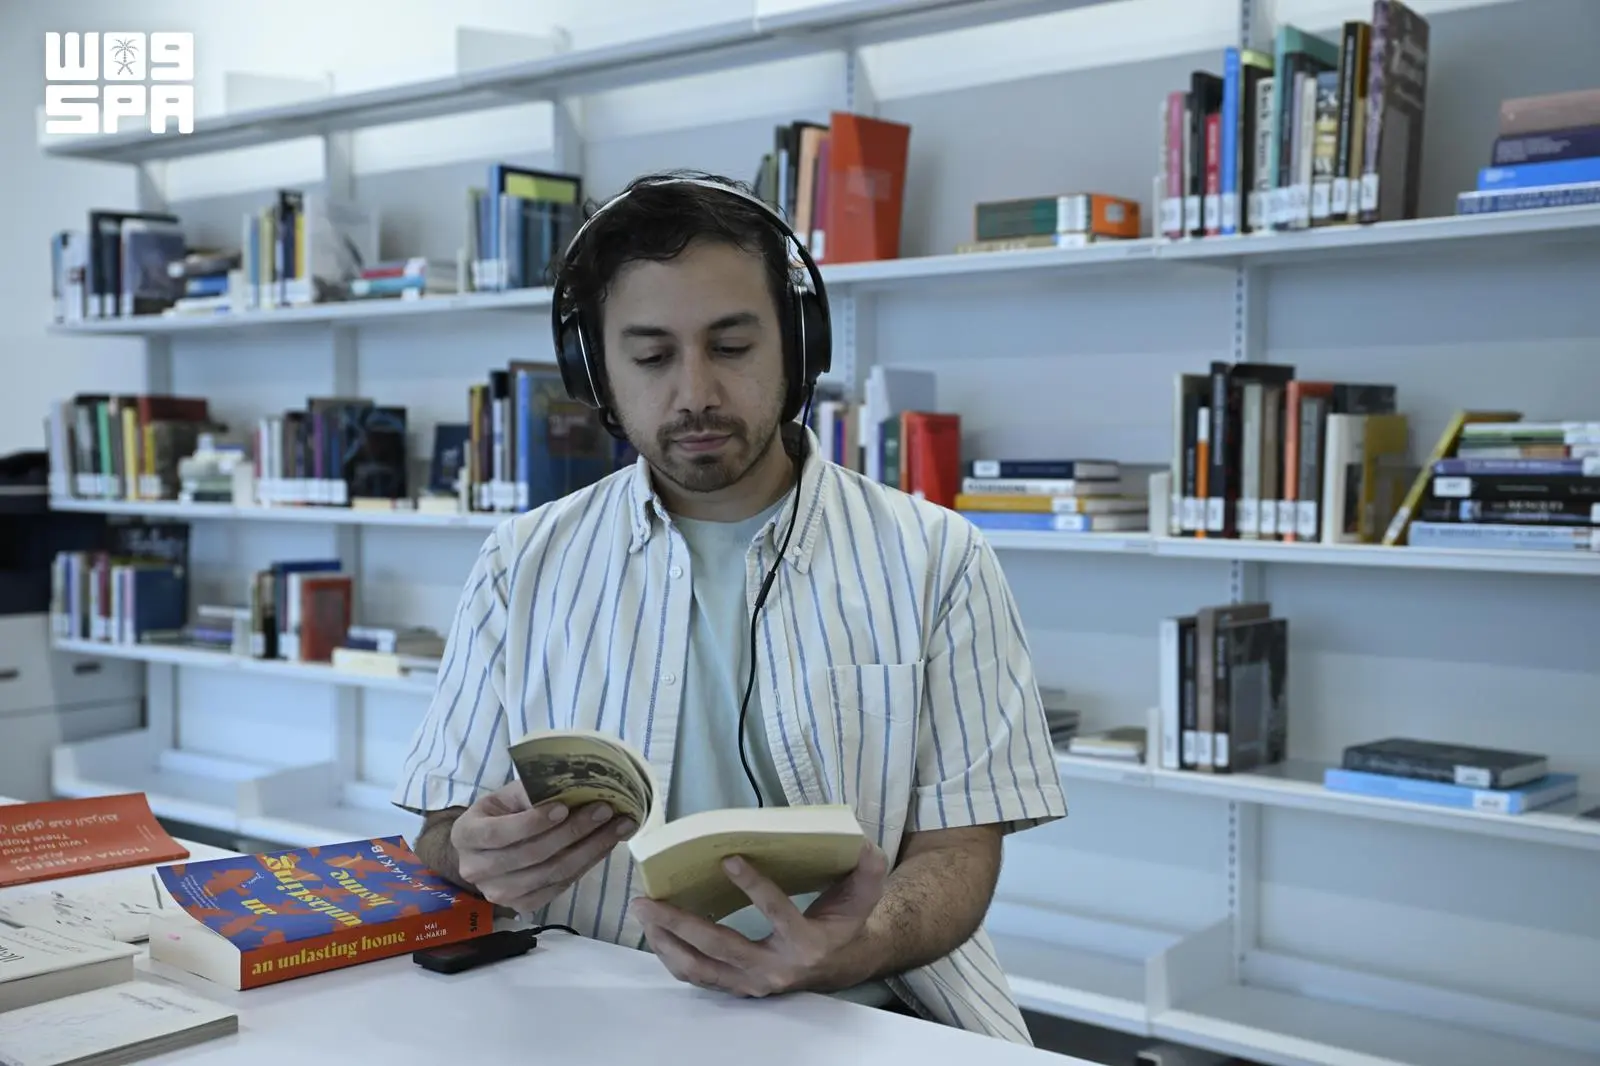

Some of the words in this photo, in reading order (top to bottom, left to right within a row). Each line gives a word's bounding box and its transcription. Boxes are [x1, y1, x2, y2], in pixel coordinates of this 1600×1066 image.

[33, 833, 70, 842] These
[2, 845, 30, 855] Fold
[33, 842, 56, 851] Not
[95, 846, 150, 859] MONA
[15, 855, 92, 871] KAREEM
[371, 844, 433, 892] AL-NAKIB
[262, 855, 362, 927] unlasting
[330, 870, 396, 907] home
[430, 890, 461, 904] MAI
[241, 898, 277, 915] an
[424, 921, 438, 931] MAI
[415, 928, 448, 942] AL-NAKIB
[251, 961, 273, 975] an
[277, 940, 359, 969] unlasting
[361, 930, 406, 951] home
